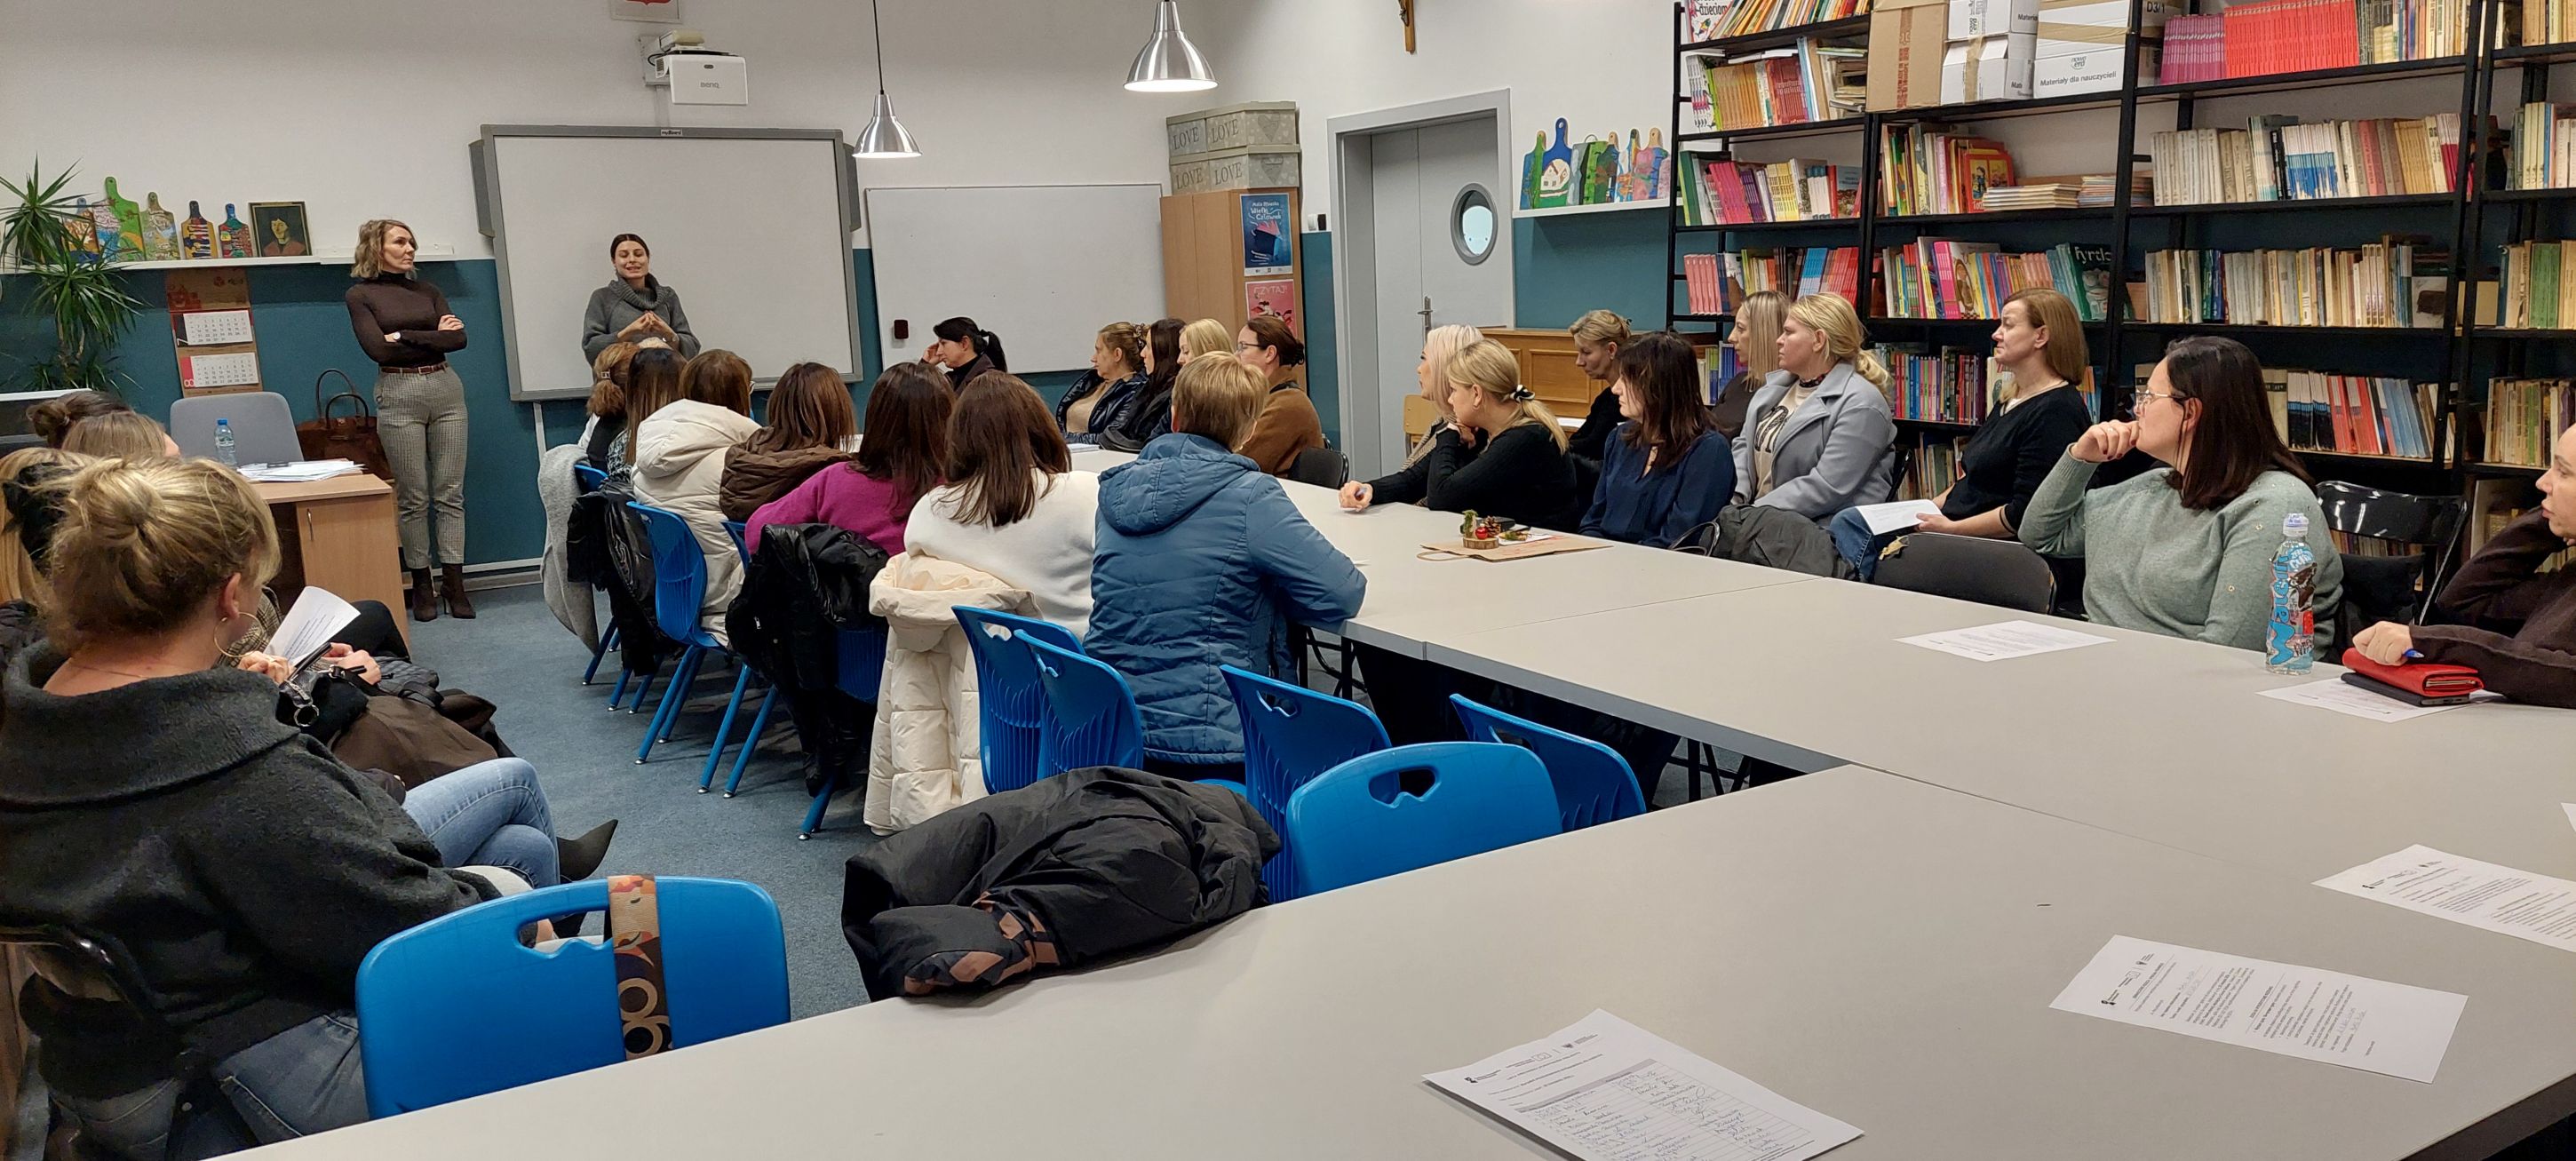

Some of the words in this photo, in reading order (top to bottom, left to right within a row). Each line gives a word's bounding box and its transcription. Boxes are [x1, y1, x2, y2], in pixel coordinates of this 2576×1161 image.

[2039, 77, 2068, 87] Materiały
[2080, 71, 2116, 82] nauczycieli
[1173, 126, 1199, 150] LOVE
[1212, 118, 1239, 143] LOVE
[1176, 167, 1204, 190] LOVE
[1214, 162, 1243, 186] LOVE
